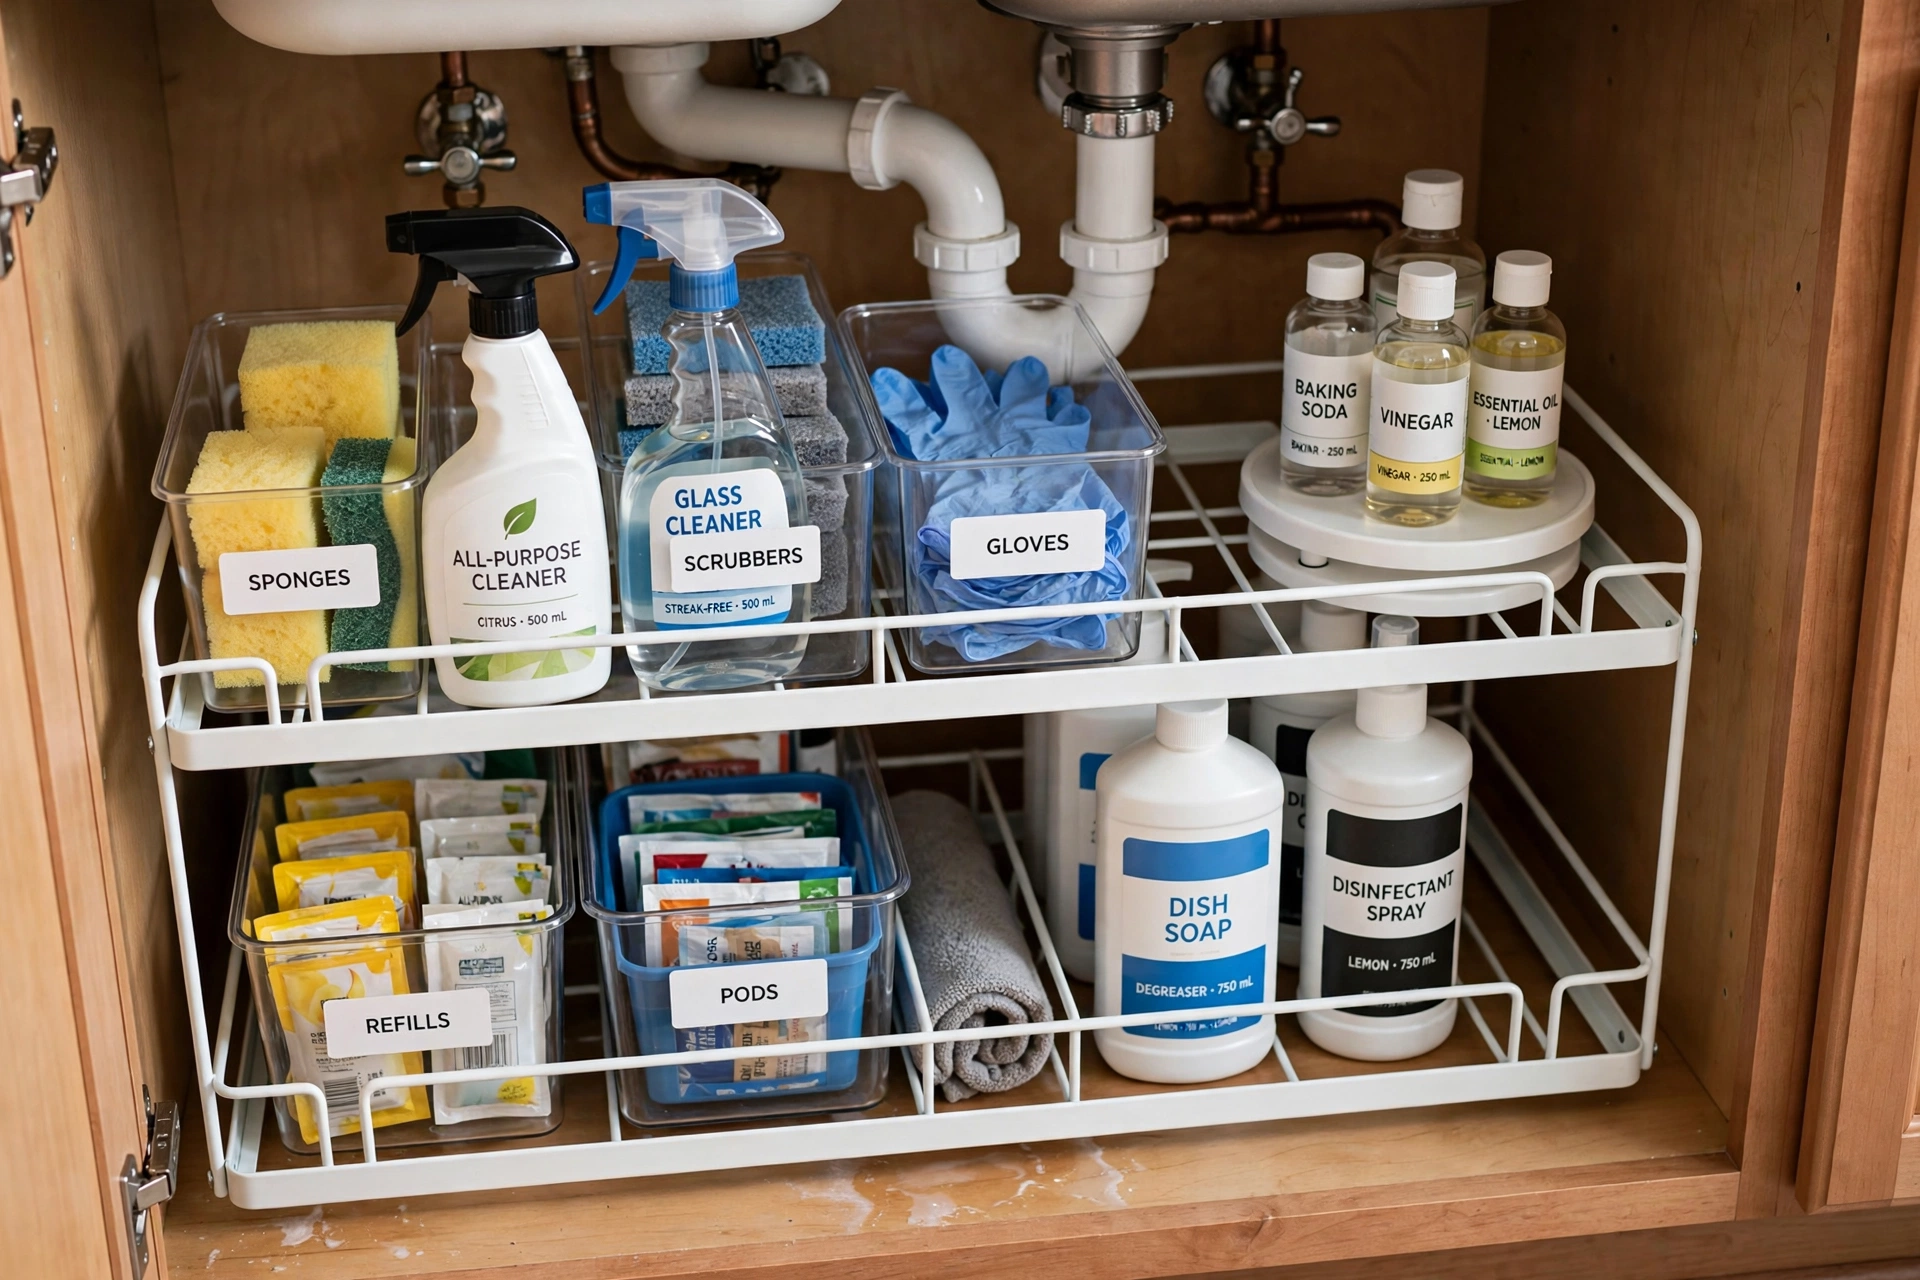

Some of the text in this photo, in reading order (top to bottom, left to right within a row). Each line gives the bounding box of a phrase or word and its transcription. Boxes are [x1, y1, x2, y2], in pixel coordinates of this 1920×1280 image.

[1296, 379, 1357, 398] BAKING
[1301, 401, 1348, 419] SODA
[1474, 391, 1558, 413] ESSENTIAL OIL
[1381, 407, 1453, 430] VINEGAR
[1493, 415, 1540, 431] LEMON
[1327, 447, 1344, 456] 250
[1346, 445, 1357, 454] mL
[1377, 464, 1451, 482] VINEGAR 250 mL
[675, 485, 742, 509] GLASS
[666, 509, 761, 536] CLEANER
[453, 540, 581, 567] ALL-PURPOSE
[986, 533, 1068, 555] GLOVES
[684, 547, 803, 572] SCRUBBERS
[249, 569, 350, 591] SPONGES
[471, 567, 567, 591] CLEANER
[665, 594, 775, 614] STREAK-FREE 500 mL
[477, 611, 567, 628] CITRUS 500 mL
[1333, 869, 1454, 900] DISINFECTANT
[1170, 894, 1227, 917] DISH
[1367, 902, 1426, 922] SPRAY
[1165, 919, 1231, 943] SOAP
[1348, 951, 1436, 971] LEMON 750 mL
[721, 984, 778, 1003] PODS
[1136, 976, 1253, 998] DEGREASER 750 mL
[366, 1012, 450, 1034] REFILLS
